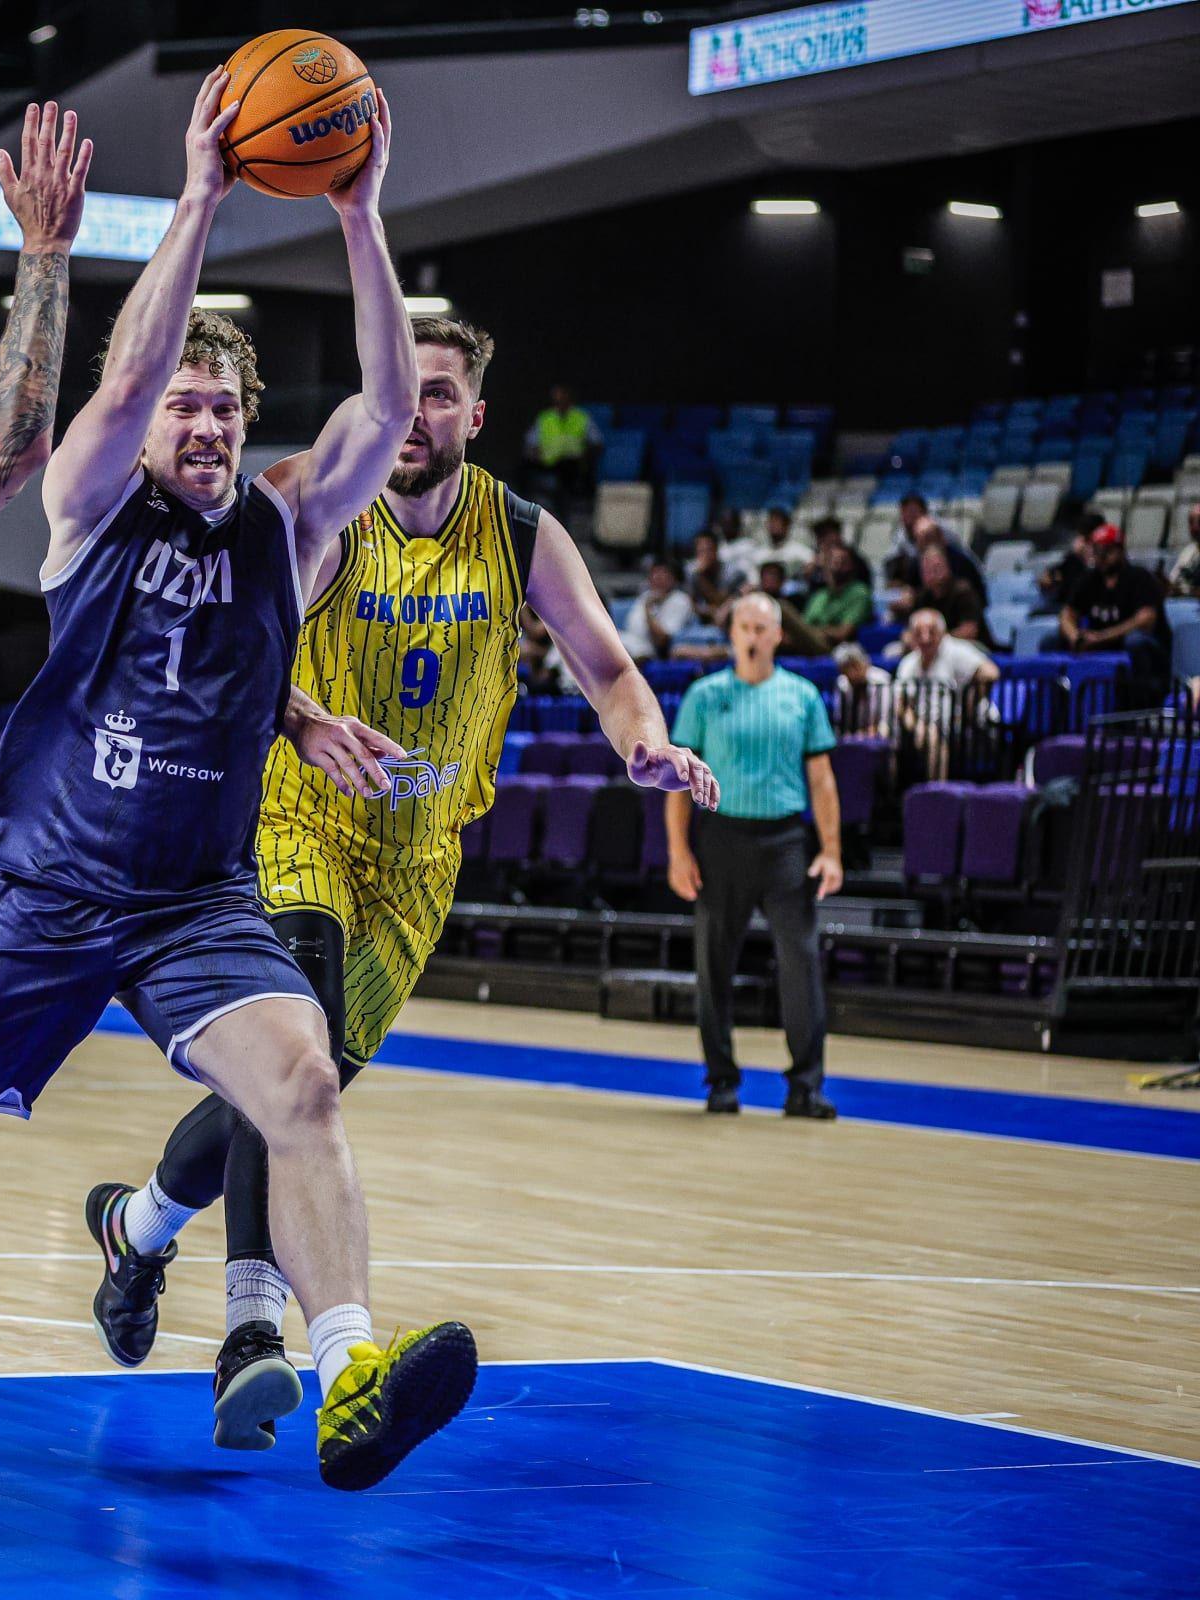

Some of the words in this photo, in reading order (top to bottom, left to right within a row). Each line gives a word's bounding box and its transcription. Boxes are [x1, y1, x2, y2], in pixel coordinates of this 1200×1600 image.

[356, 590, 395, 625] BK
[400, 591, 489, 625] OPAVA
[165, 626, 187, 691] 1
[399, 648, 440, 709] 9
[147, 756, 225, 782] Warsaw
